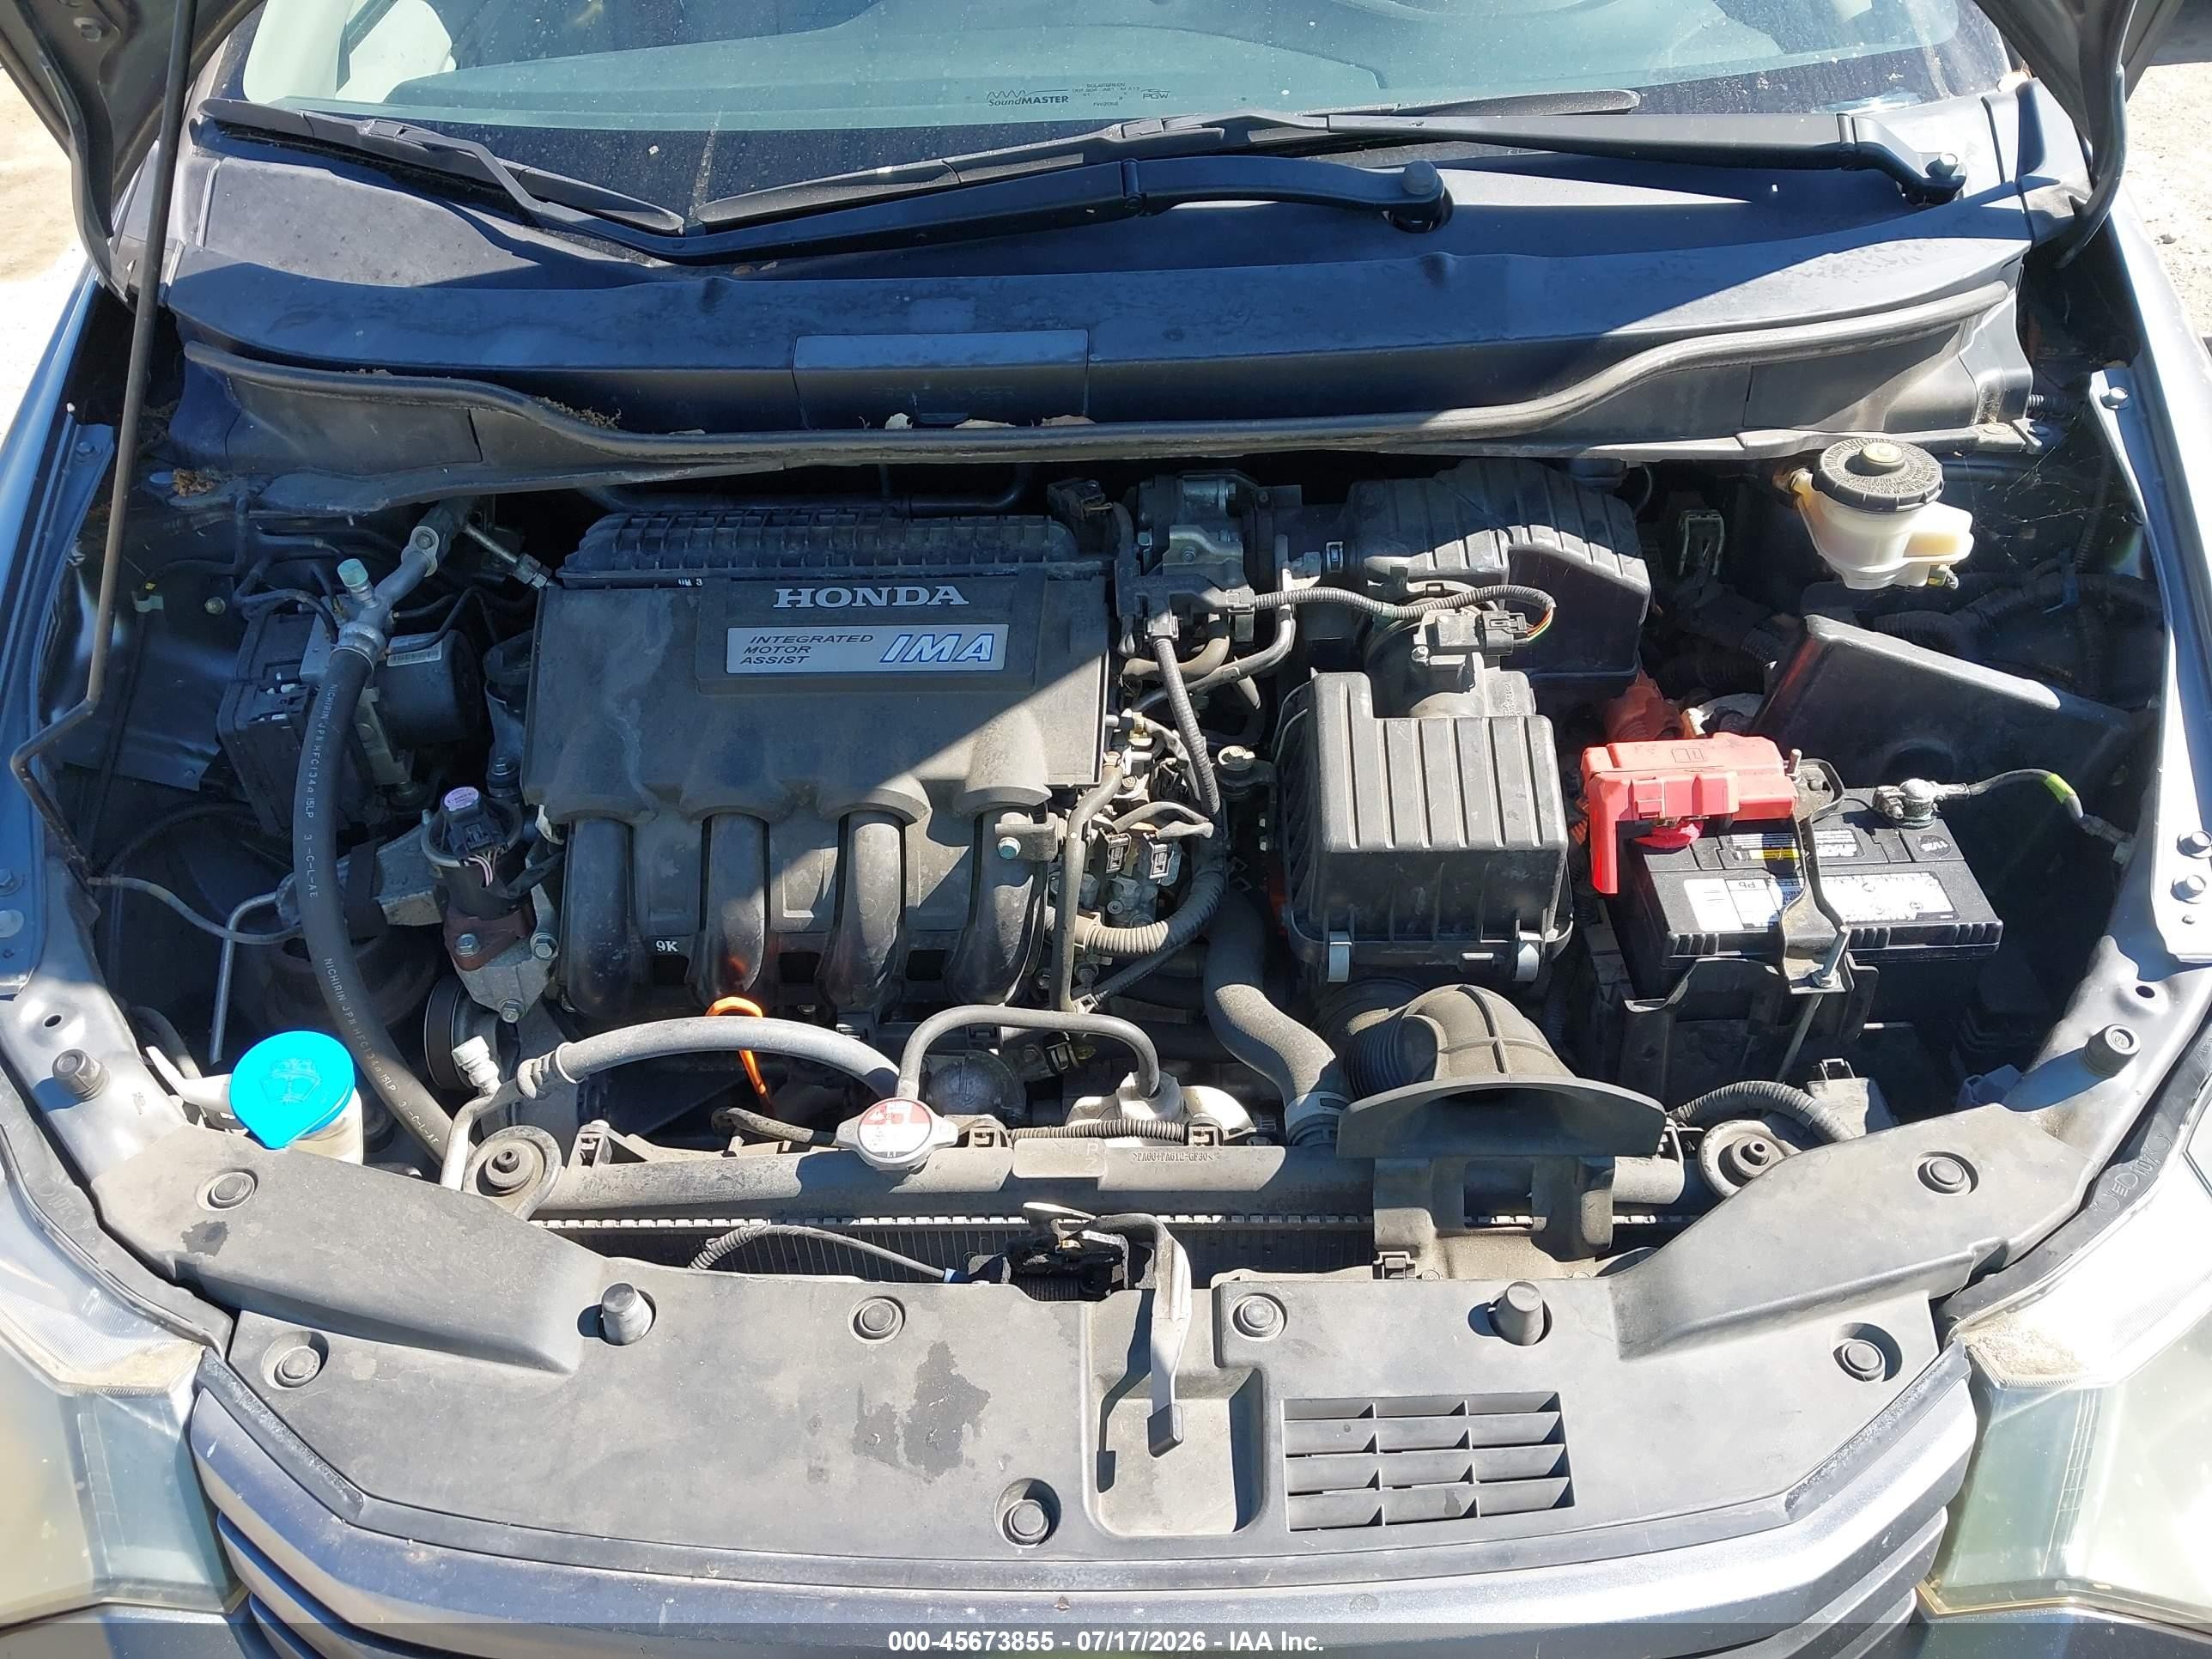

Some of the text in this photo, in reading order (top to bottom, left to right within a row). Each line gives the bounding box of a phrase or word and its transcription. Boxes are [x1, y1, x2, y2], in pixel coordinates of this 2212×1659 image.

[988, 95, 1069, 106] SoundMASTER
[773, 586, 969, 609] HONDA
[750, 634, 874, 644] INTEGRATED
[744, 646, 811, 654] MOTOR
[879, 632, 996, 663] IMA
[739, 655, 811, 665] ASSIST
[320, 684, 337, 720] NICHIRIN
[315, 723, 326, 742] JPN
[655, 939, 679, 952] 9K
[323, 957, 347, 1002] NICHIRIN
